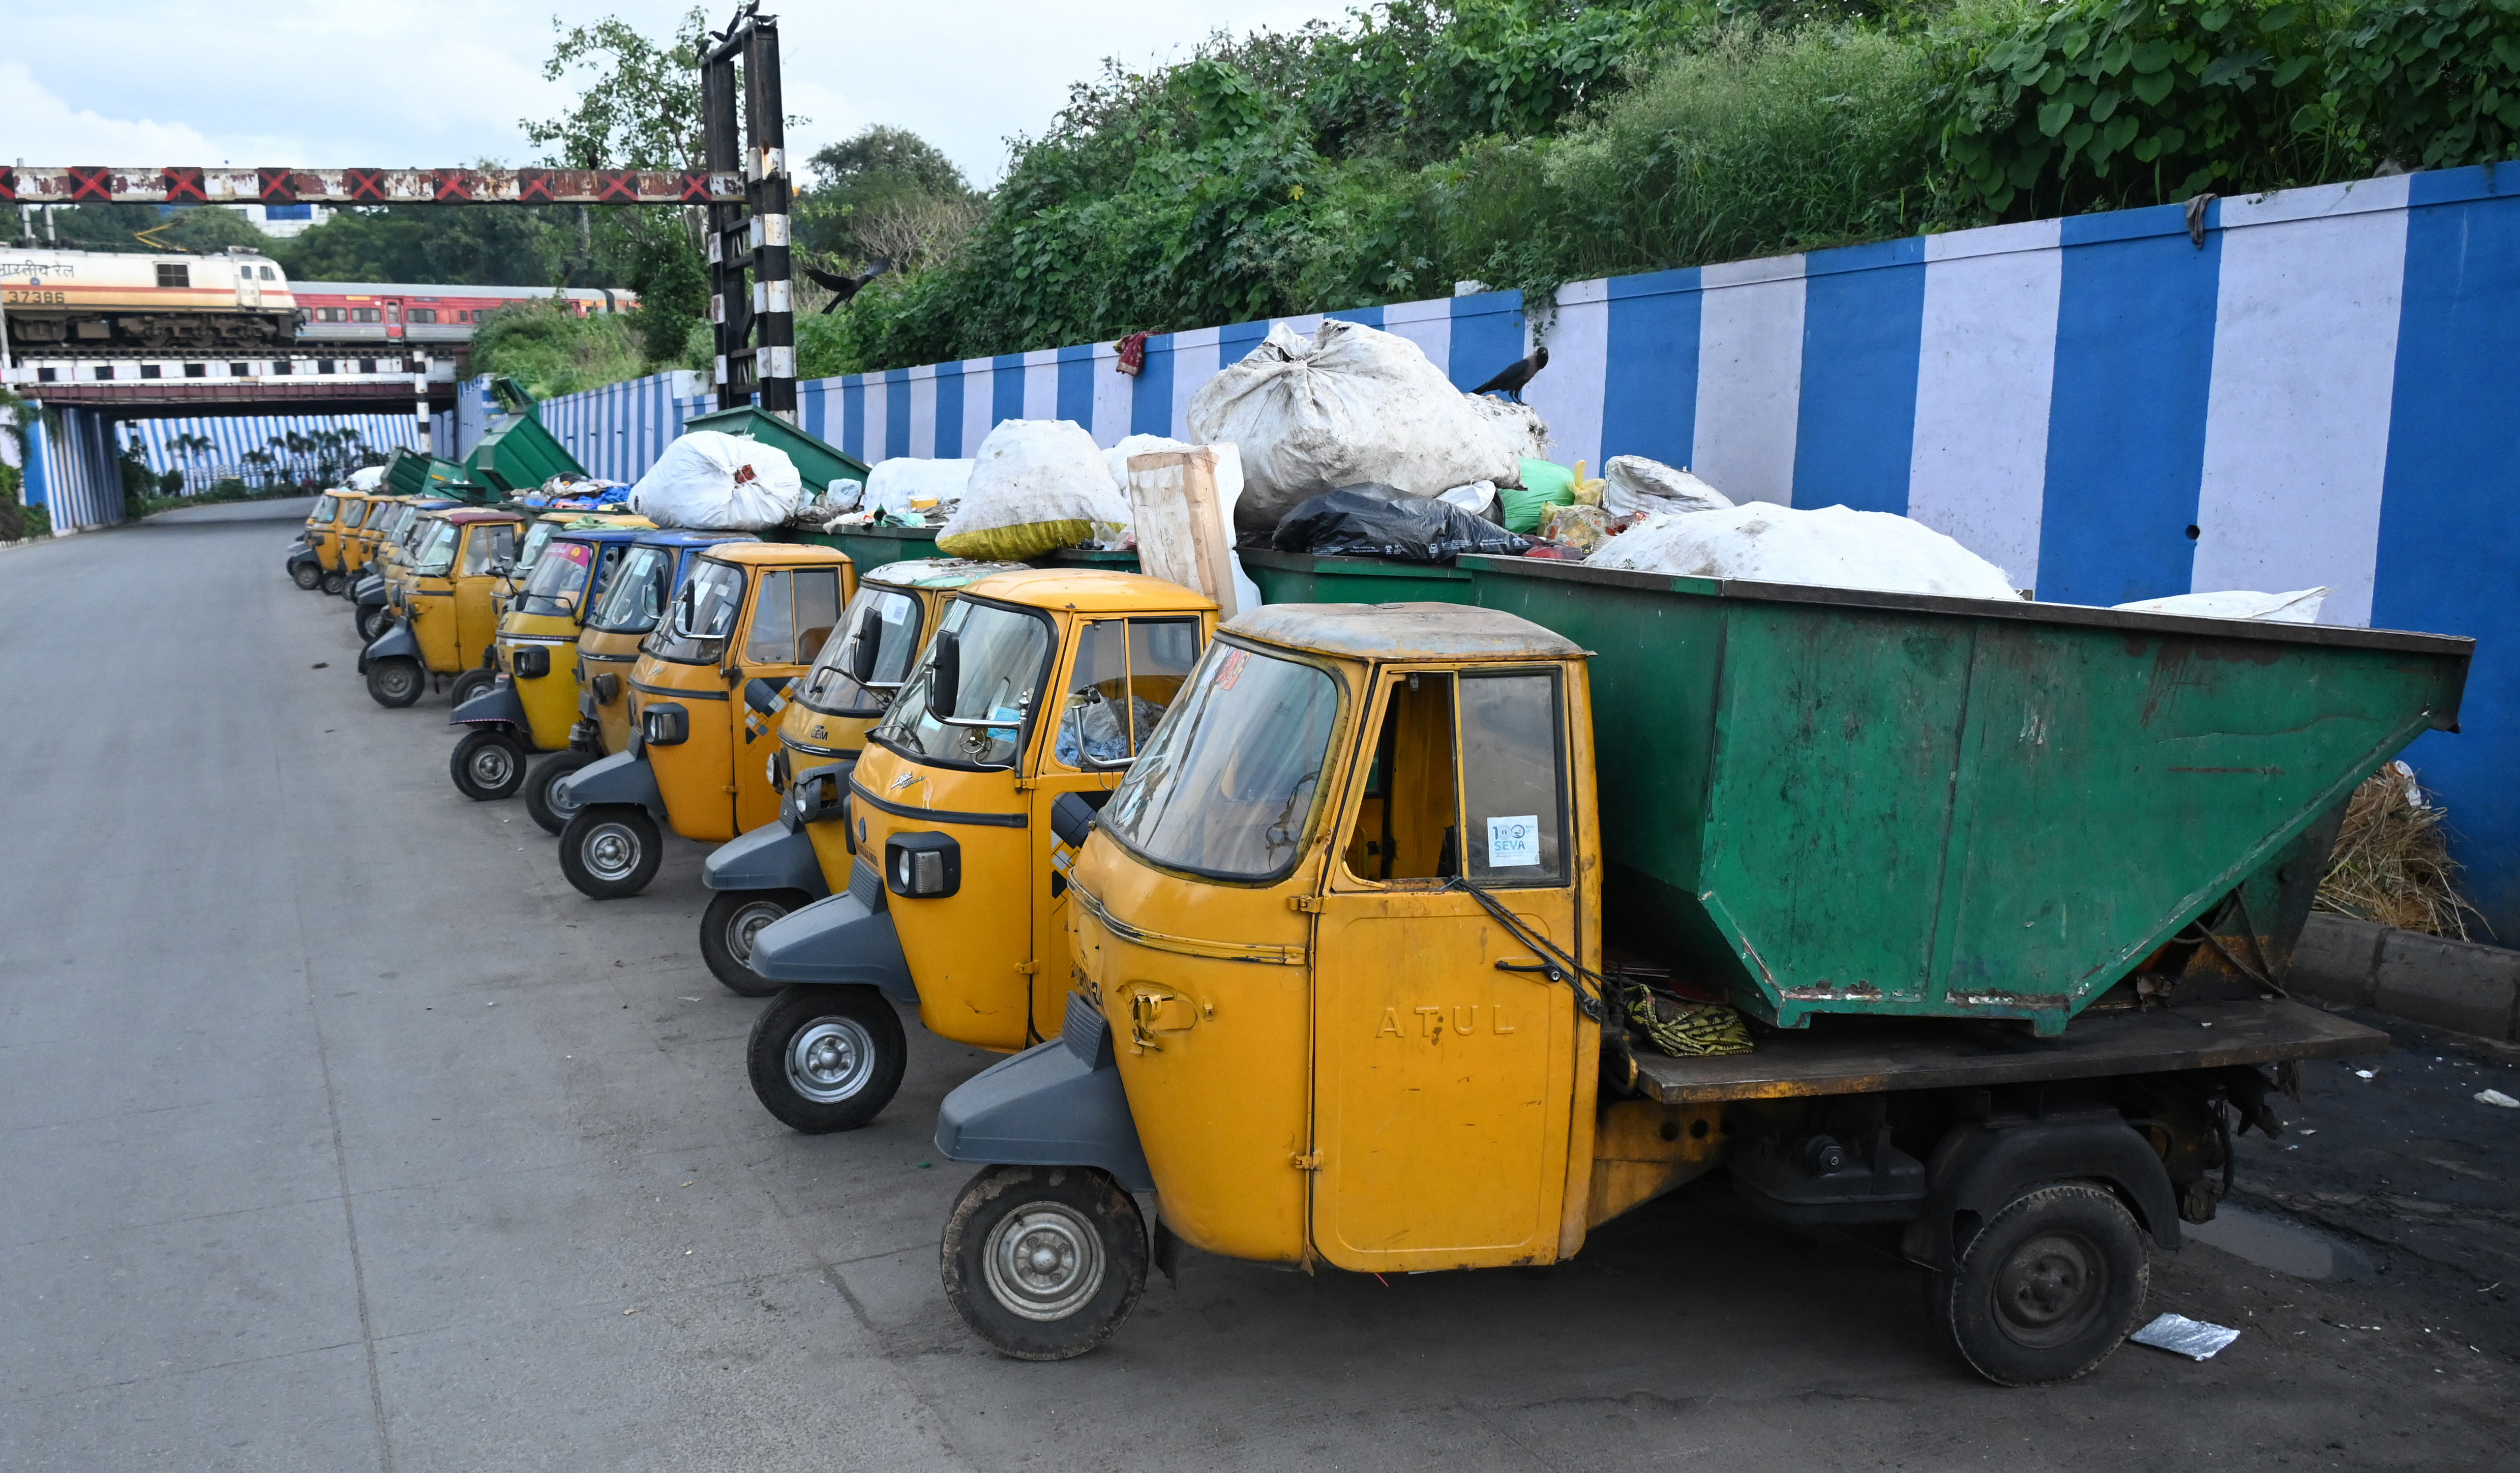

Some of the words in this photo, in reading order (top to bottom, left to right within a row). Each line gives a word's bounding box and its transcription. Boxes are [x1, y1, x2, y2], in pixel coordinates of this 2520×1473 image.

[52, 260, 74, 277] रेल
[9, 291, 64, 304] 37386
[1492, 824, 1525, 840] 100
[1494, 840, 1525, 851] SEVA
[1375, 1005, 1515, 1038] ATUL
